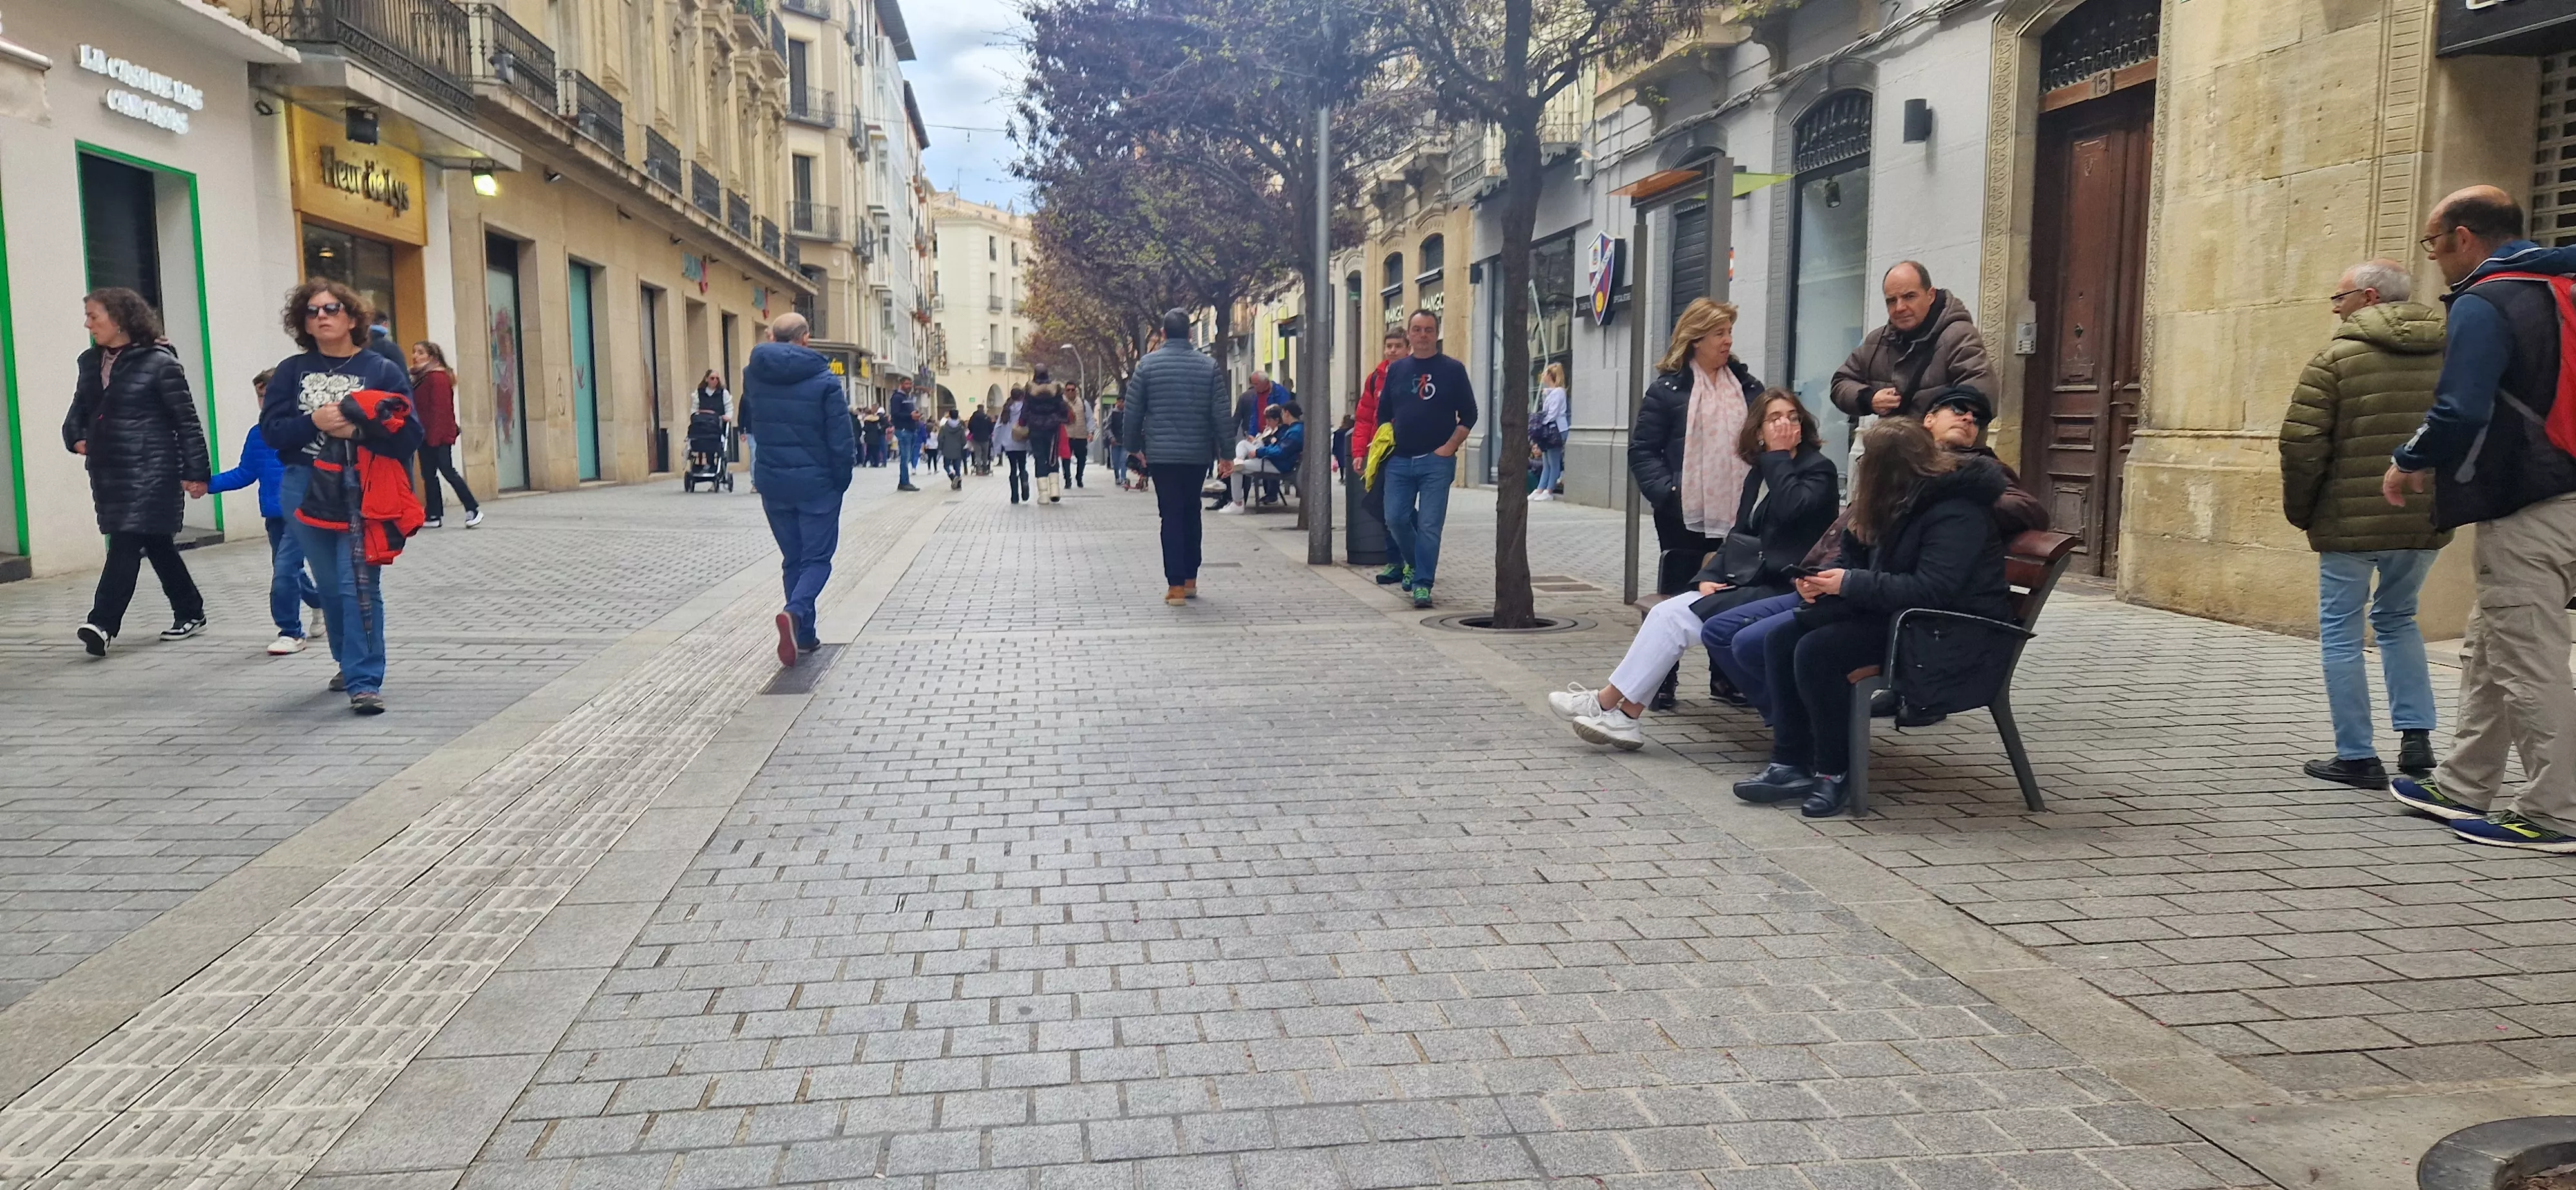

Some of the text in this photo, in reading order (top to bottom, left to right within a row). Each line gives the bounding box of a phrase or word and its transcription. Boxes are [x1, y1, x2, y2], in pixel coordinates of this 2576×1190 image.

[80, 44, 203, 111] LA CASA DE LAS
[2092, 72, 2108, 95] 15
[107, 89, 189, 135] CARCASAS
